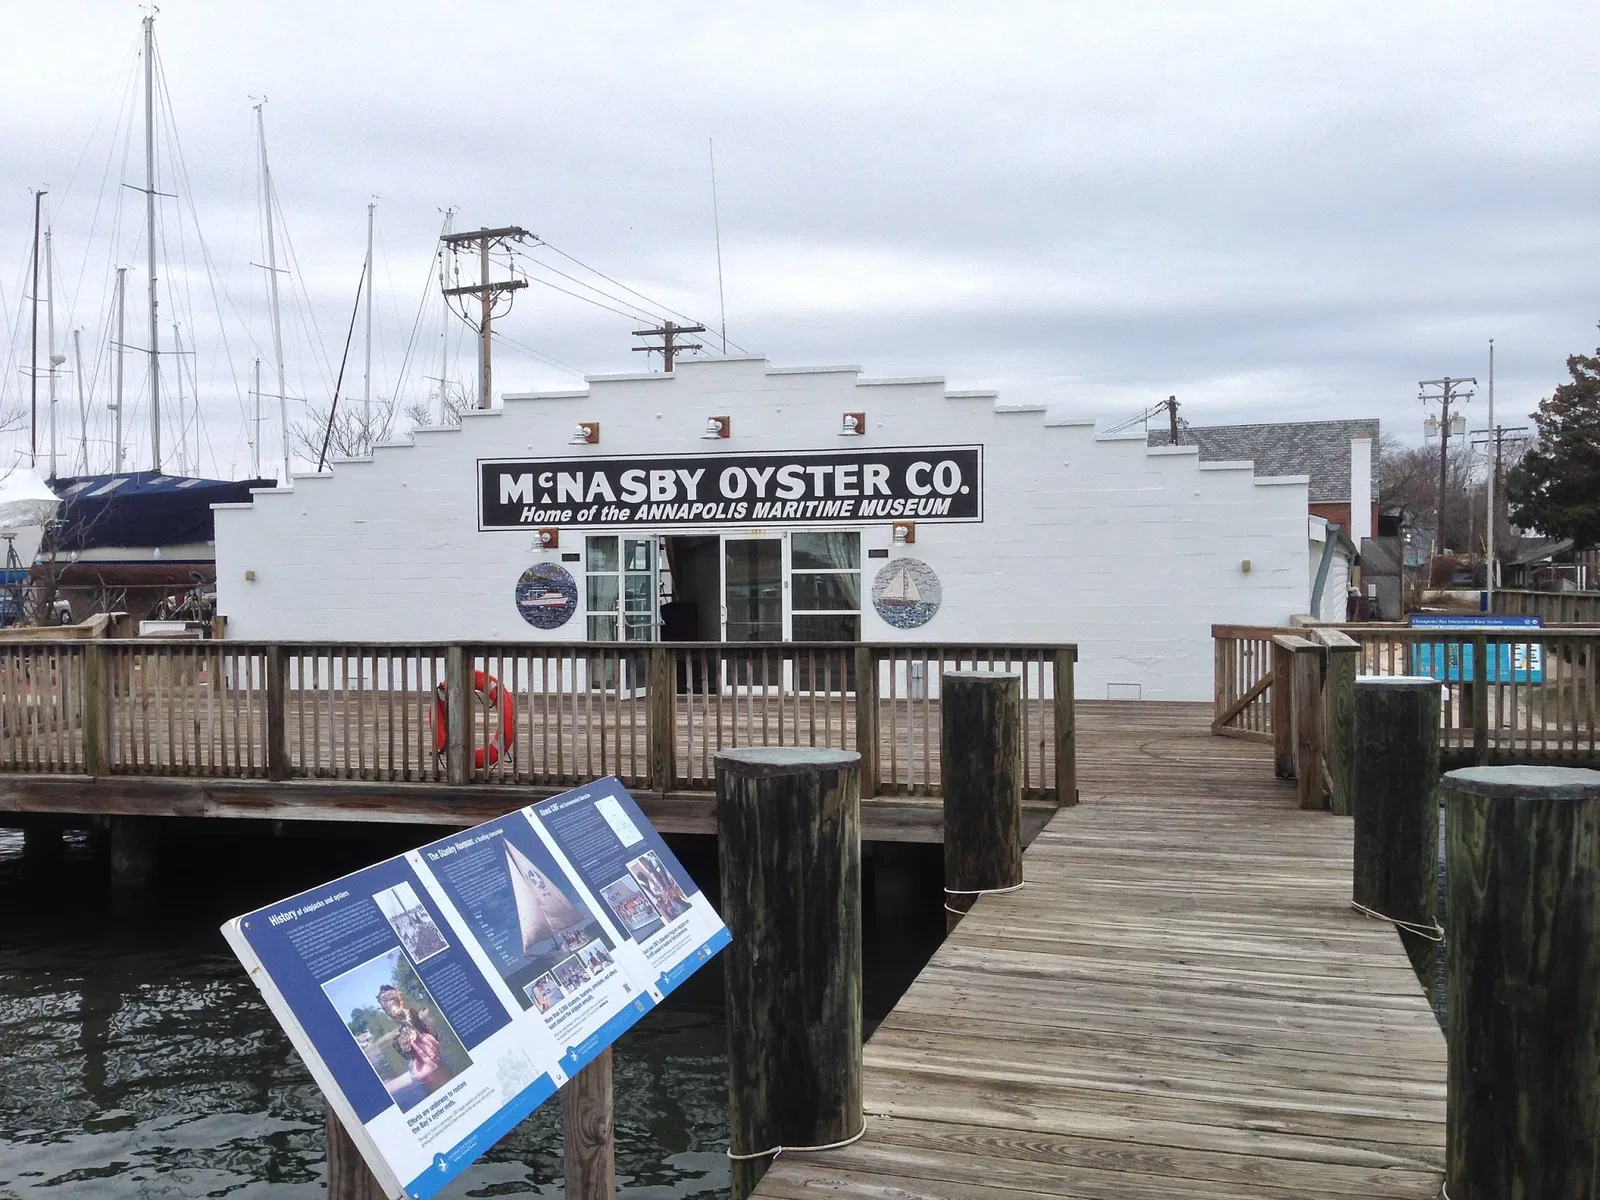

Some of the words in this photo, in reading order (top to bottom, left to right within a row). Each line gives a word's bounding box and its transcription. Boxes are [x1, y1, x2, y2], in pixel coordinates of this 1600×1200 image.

[719, 464, 892, 500] OYSTER
[905, 460, 970, 495] CO.
[520, 506, 572, 523] Home
[576, 505, 598, 522] of
[600, 504, 631, 521] the
[634, 501, 749, 521] ANNAPOLIS
[752, 499, 855, 519] MARITIME
[858, 498, 952, 517] MUSEUM
[427, 853, 440, 861] The
[438, 846, 457, 857] Stanley
[269, 910, 296, 926] History
[297, 908, 303, 916] of
[303, 901, 325, 913] skipjacks
[324, 896, 334, 904] and
[333, 891, 349, 901] oysters
[544, 1016, 553, 1024] More
[407, 1114, 422, 1127] Efforts
[422, 1108, 430, 1116] are
[429, 1095, 448, 1110] underway
[452, 1081, 467, 1093] restore
[411, 1126, 420, 1134] the
[419, 1117, 432, 1128] Bay's
[431, 1108, 444, 1120] oyster
[444, 1100, 456, 1110] reefs.
